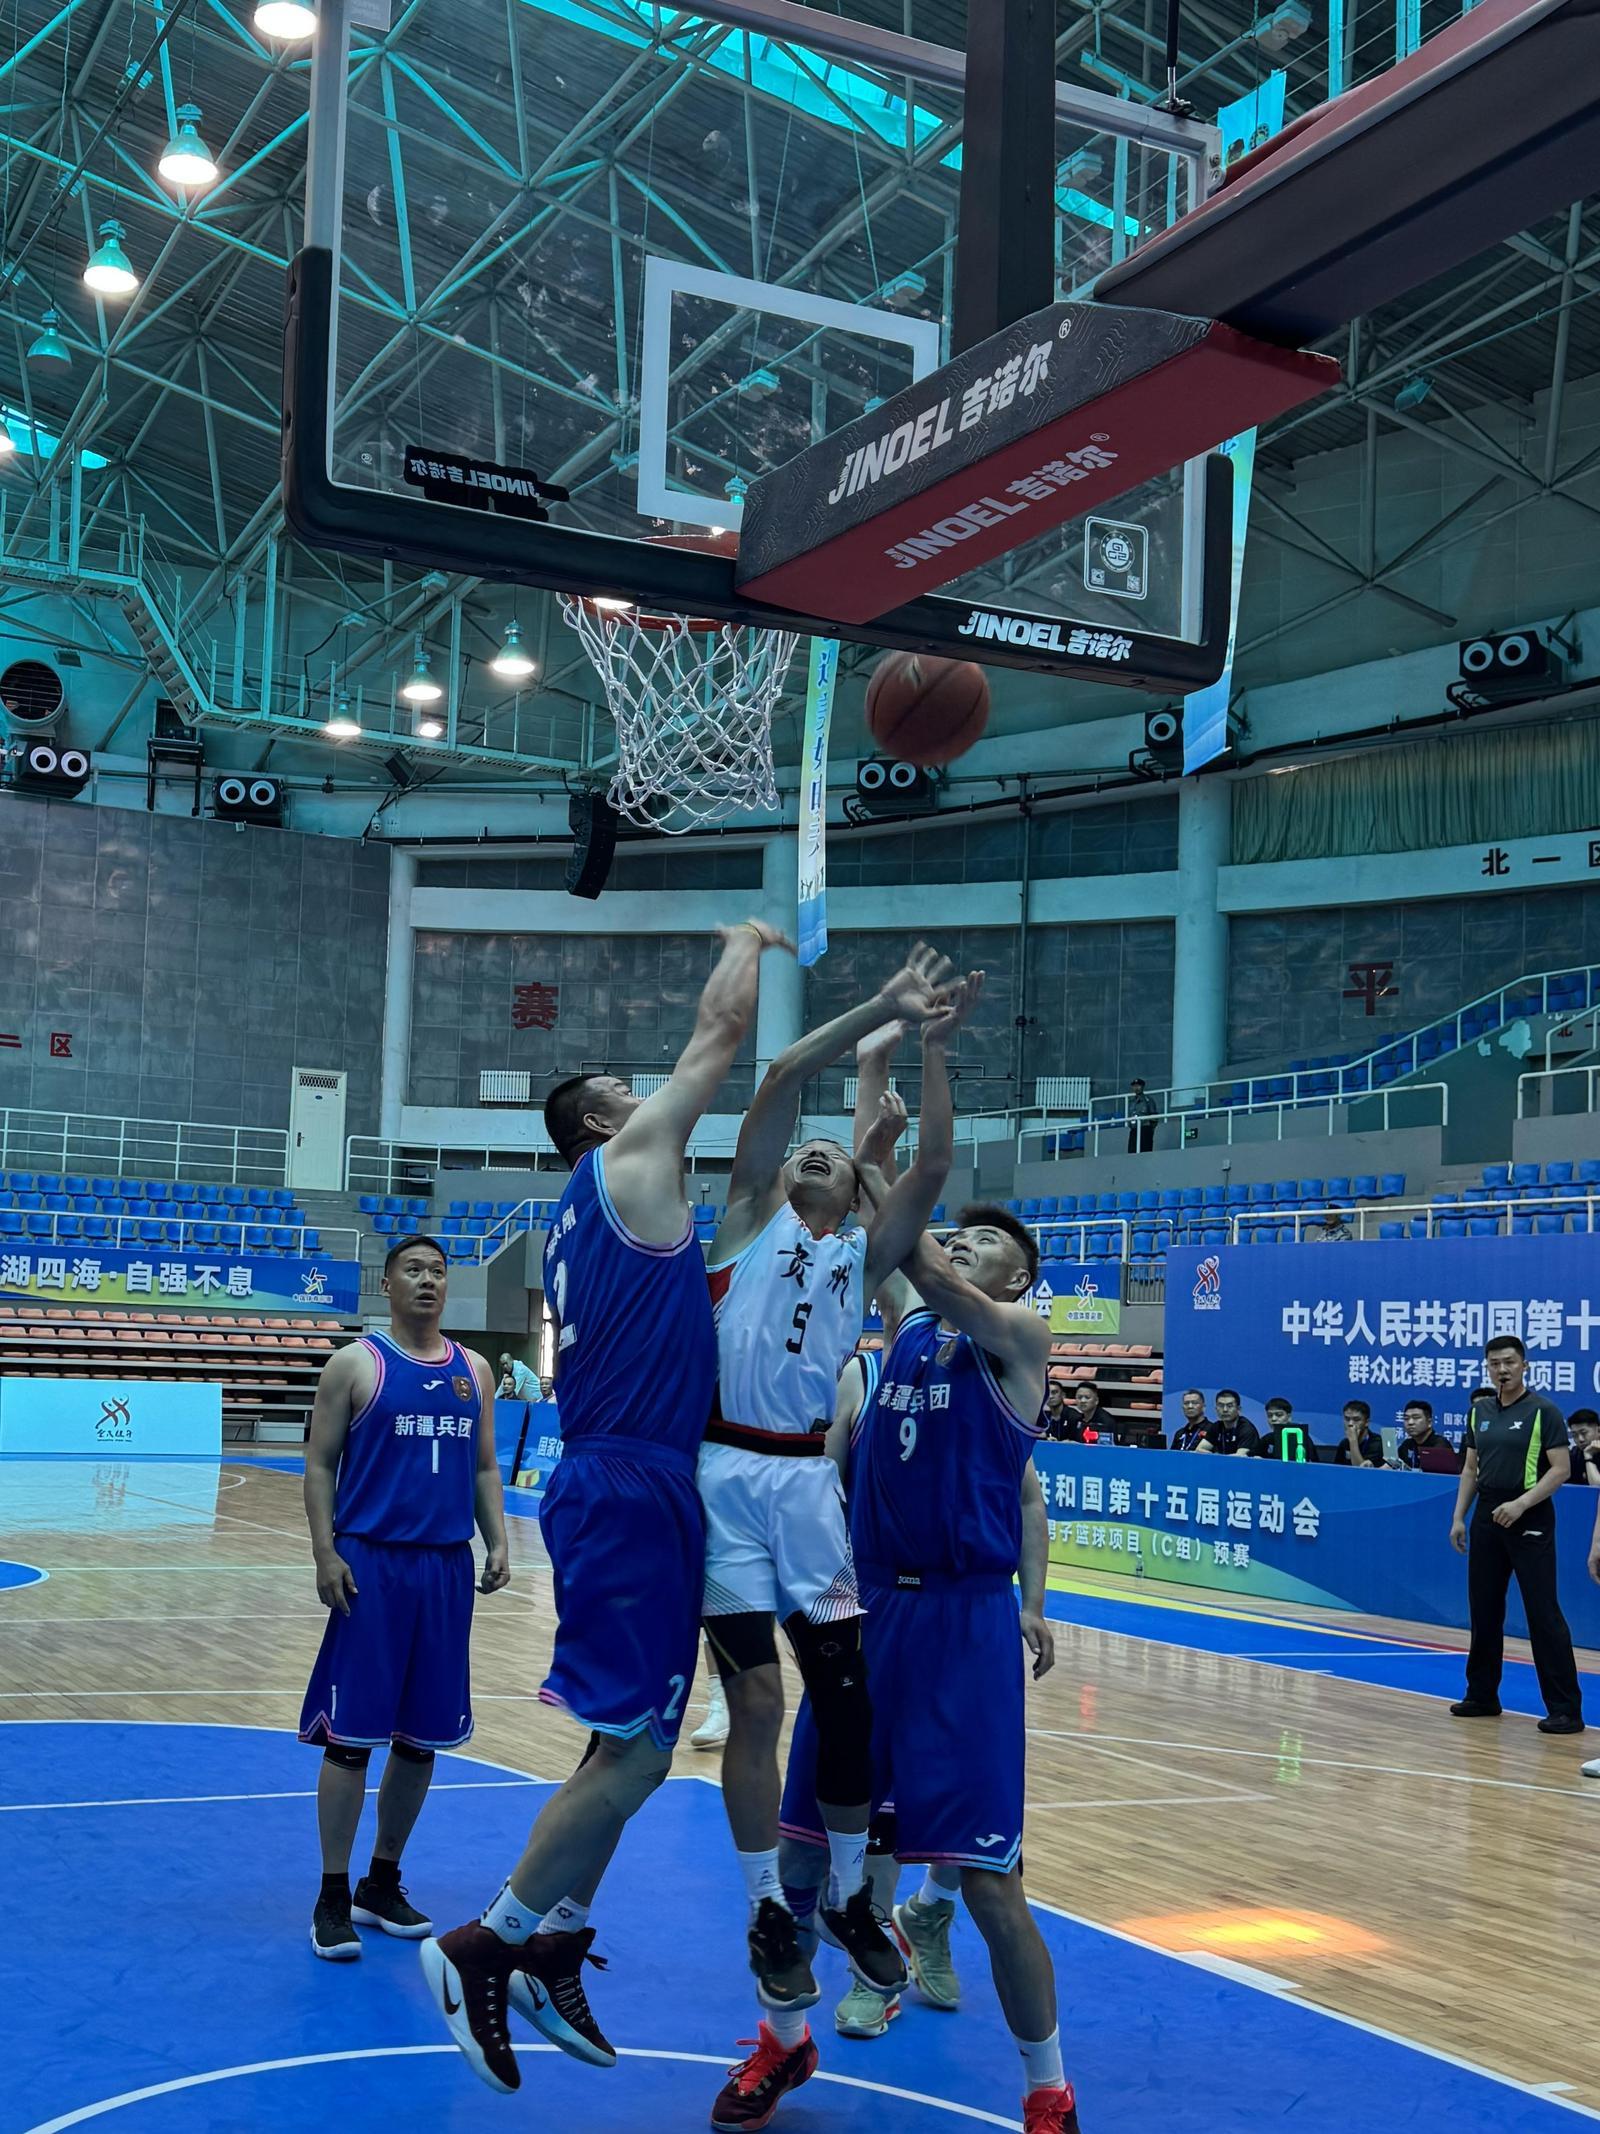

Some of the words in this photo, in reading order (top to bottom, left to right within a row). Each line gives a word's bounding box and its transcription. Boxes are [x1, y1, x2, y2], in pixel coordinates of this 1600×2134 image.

[829, 397, 953, 504] JINOEL
[959, 341, 1053, 432] 吉诺尔
[884, 497, 1030, 569] JINOEL
[1005, 445, 1118, 500] 吉诺尔
[958, 611, 1066, 652] JINOEL
[1067, 629, 1133, 661] 吉诺尔
[513, 981, 559, 1031] 赛
[1343, 961, 1400, 1016] 平
[777, 1242, 853, 1309] 贵州
[785, 1302, 813, 1355] 5
[1282, 1299, 1600, 1350] 中华人民共和国第十
[879, 1381, 951, 1414] 新疆兵团
[395, 1414, 473, 1438] 新疆兵团
[899, 1417, 917, 1461] 9
[432, 1439, 439, 1474] 1
[1036, 1470, 1320, 1538] 共和国第十五届运动会
[662, 1675, 685, 1720] 2
